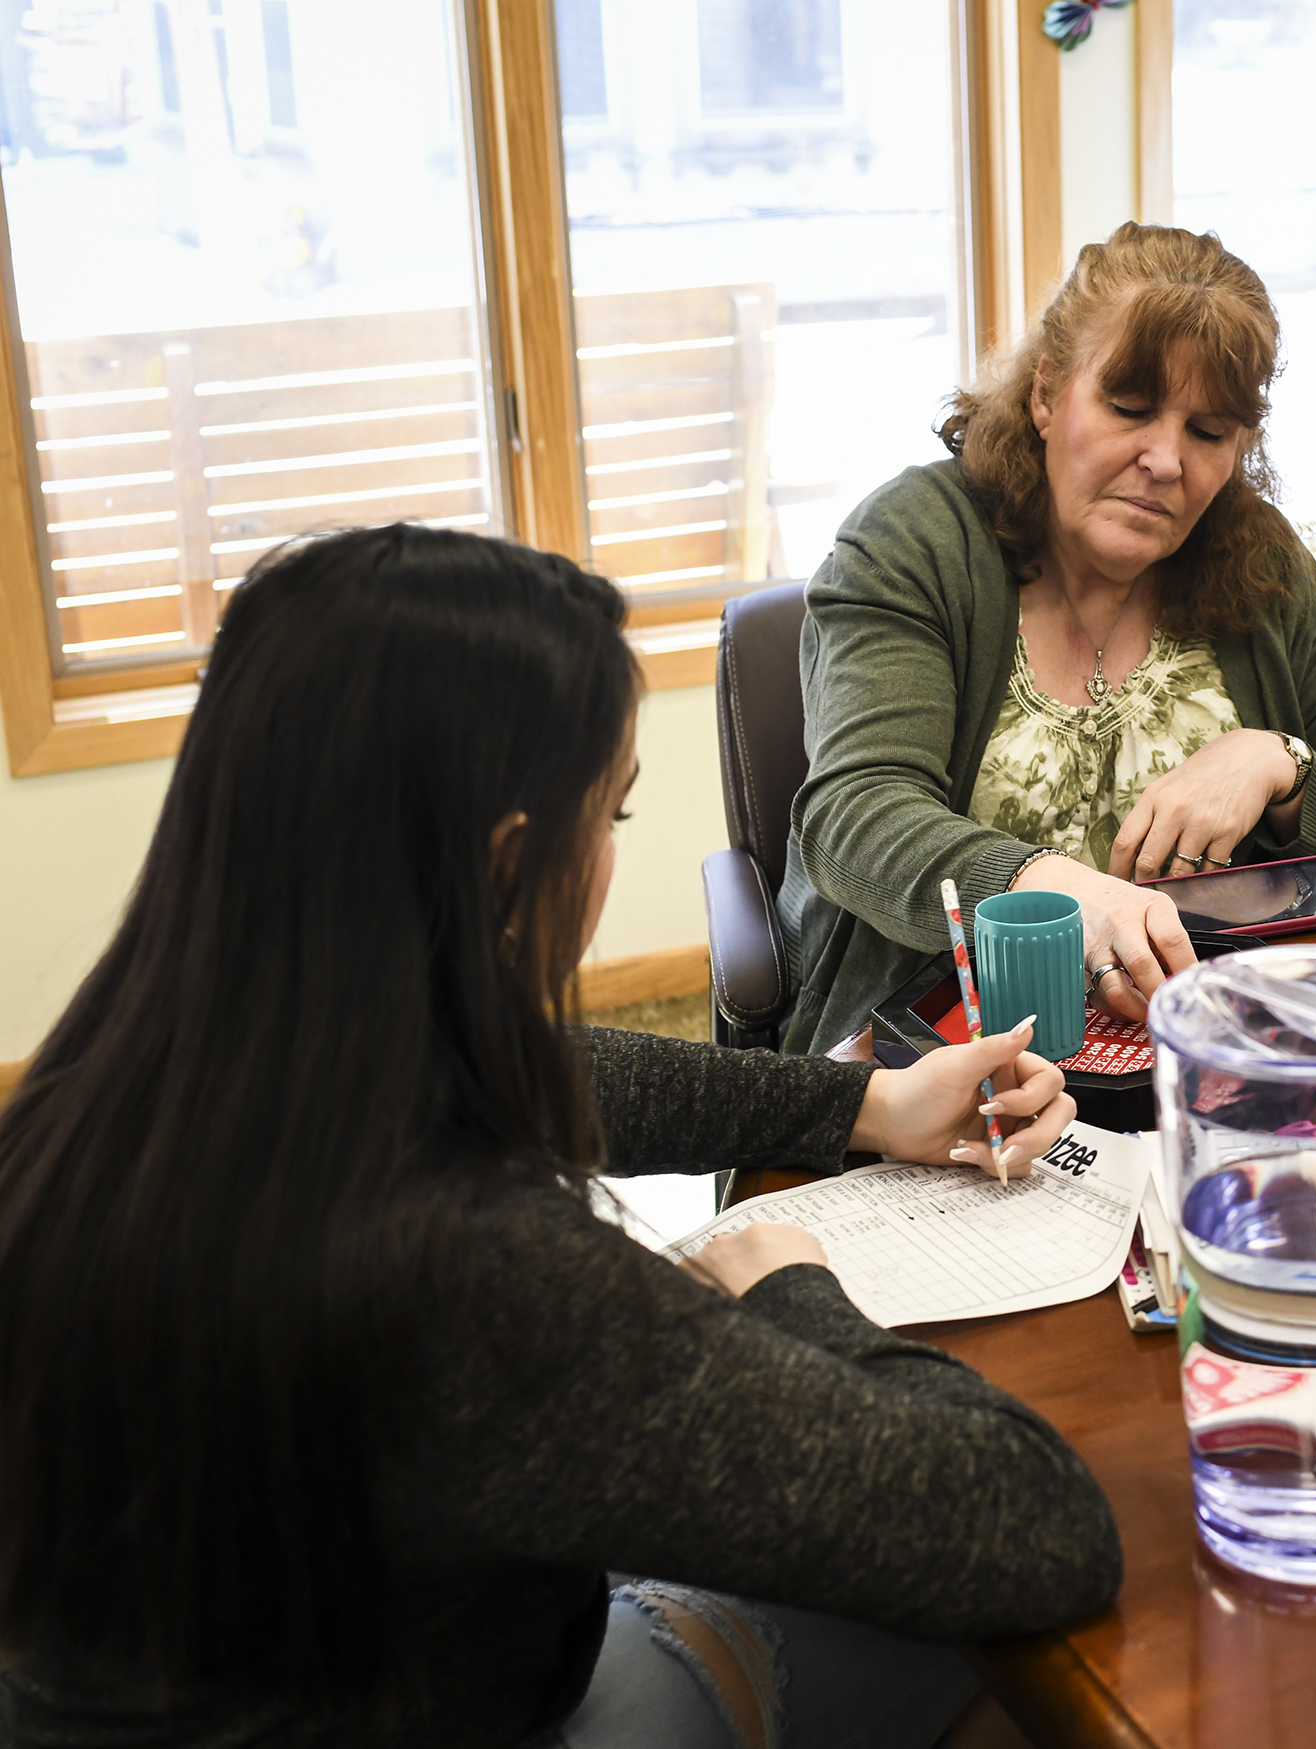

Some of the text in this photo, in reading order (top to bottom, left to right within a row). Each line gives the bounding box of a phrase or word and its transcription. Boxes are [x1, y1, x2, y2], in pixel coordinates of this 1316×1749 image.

[1086, 1042, 1106, 1056] 200
[1103, 1044, 1122, 1057] 300
[1120, 1045, 1138, 1058] 400
[1135, 1047, 1153, 1060] 500
[1041, 1134, 1098, 1176] tzee
